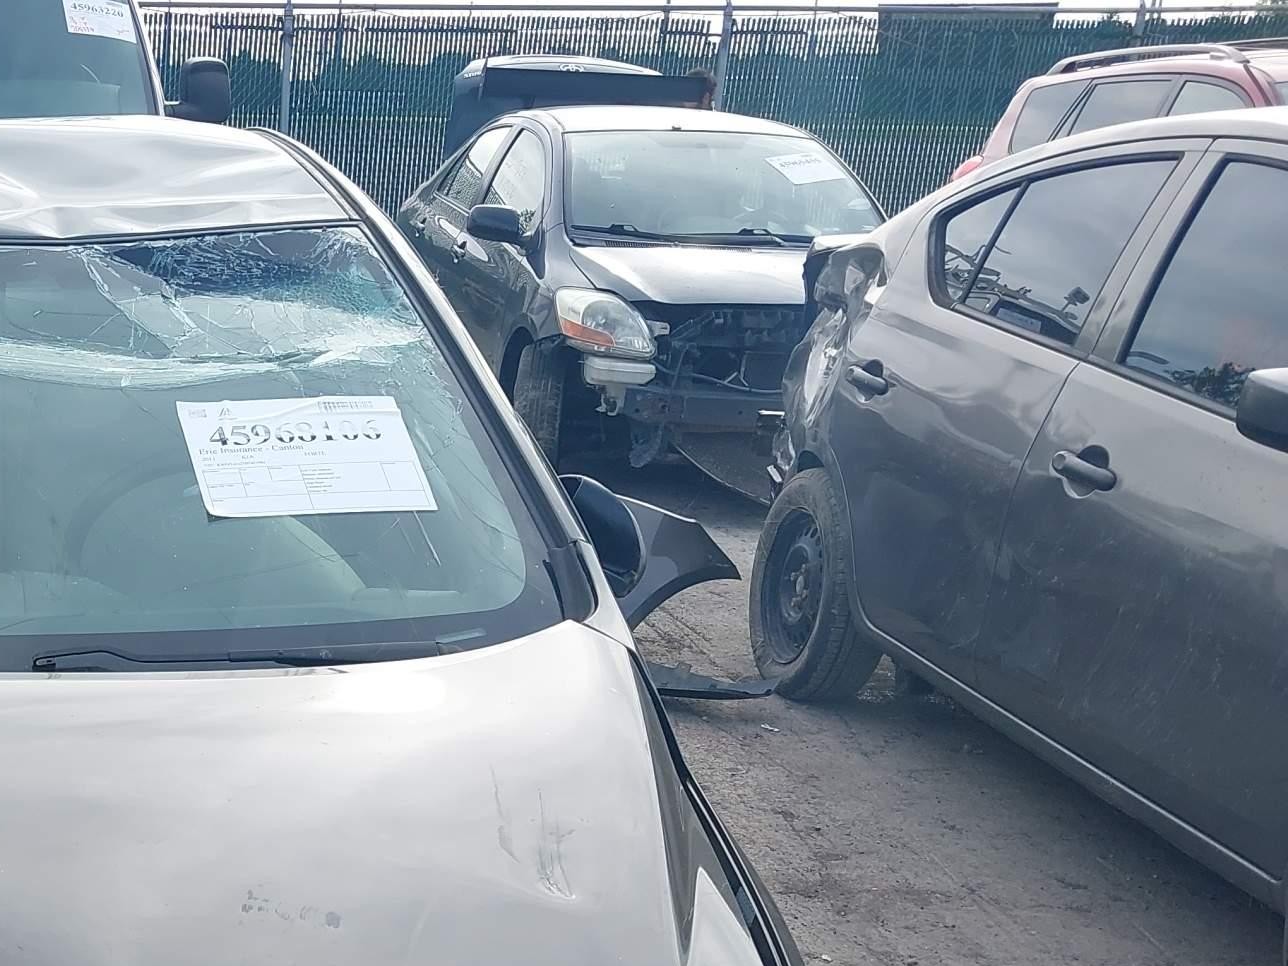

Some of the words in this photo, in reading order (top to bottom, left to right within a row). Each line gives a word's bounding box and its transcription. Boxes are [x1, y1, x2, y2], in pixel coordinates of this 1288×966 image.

[209, 419, 383, 446] 45968106
[220, 446, 263, 454] Insurance
[271, 444, 304, 452] Canton
